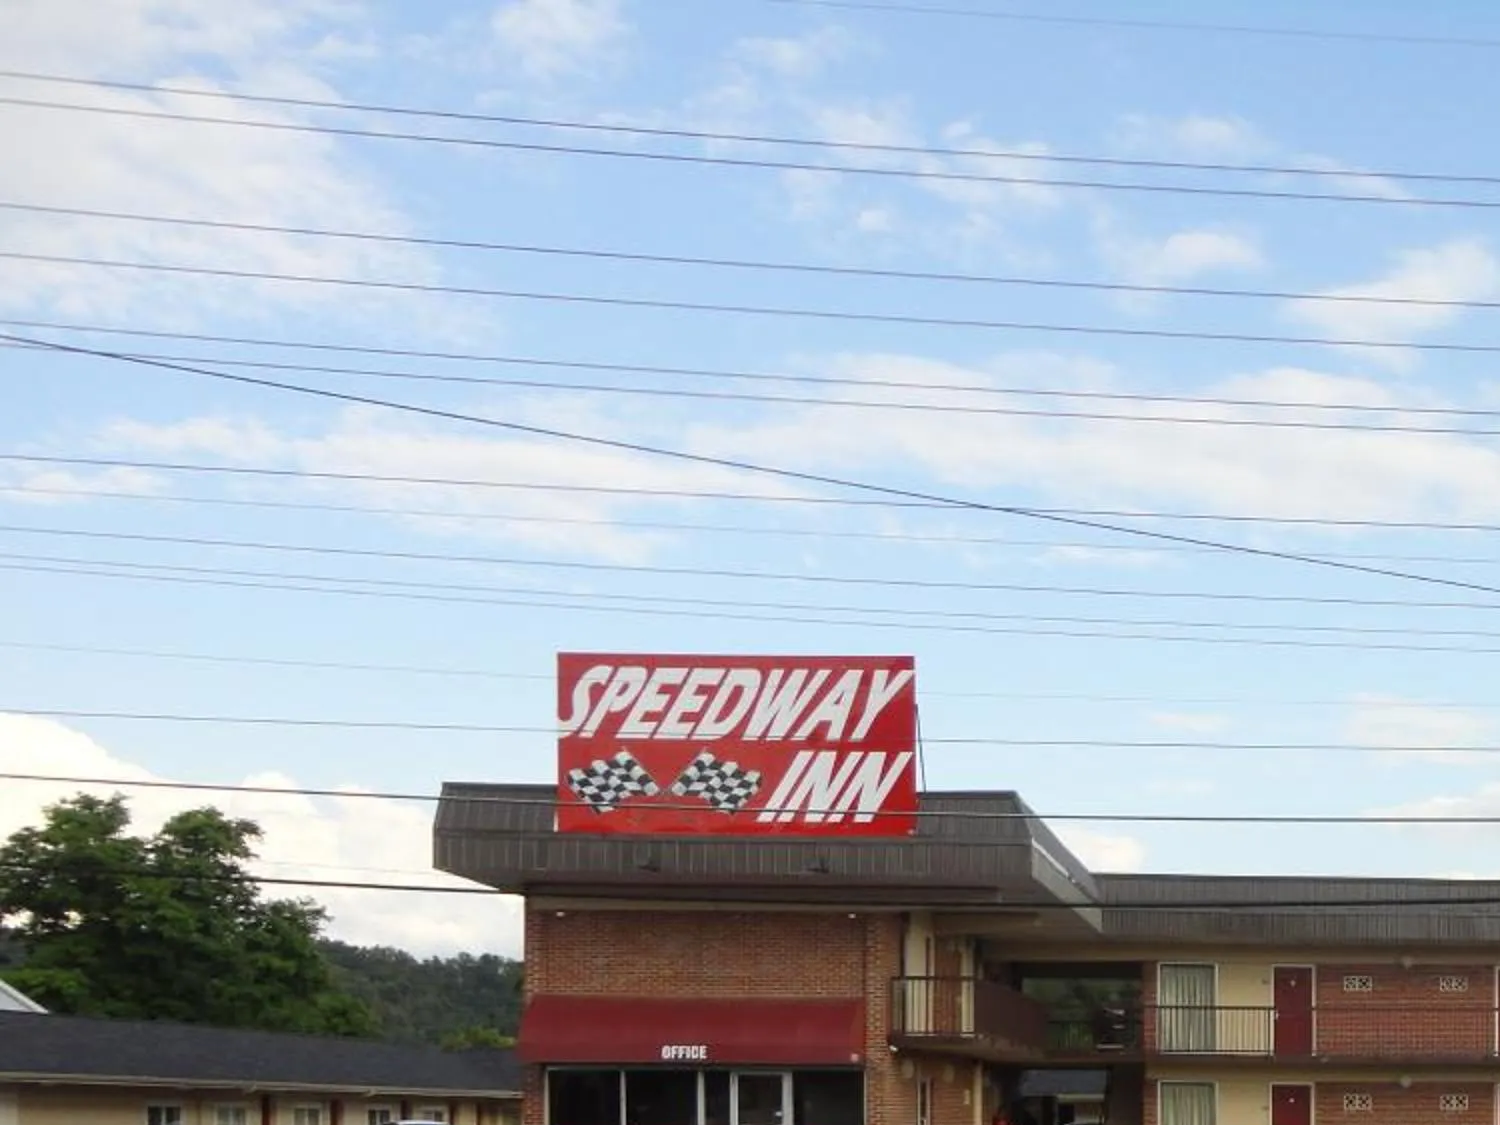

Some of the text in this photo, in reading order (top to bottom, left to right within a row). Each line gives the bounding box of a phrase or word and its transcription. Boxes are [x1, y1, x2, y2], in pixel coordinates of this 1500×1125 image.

[557, 665, 914, 741] SPEEDWAY
[756, 751, 913, 823] INN
[661, 1045, 707, 1060] OFFICE
